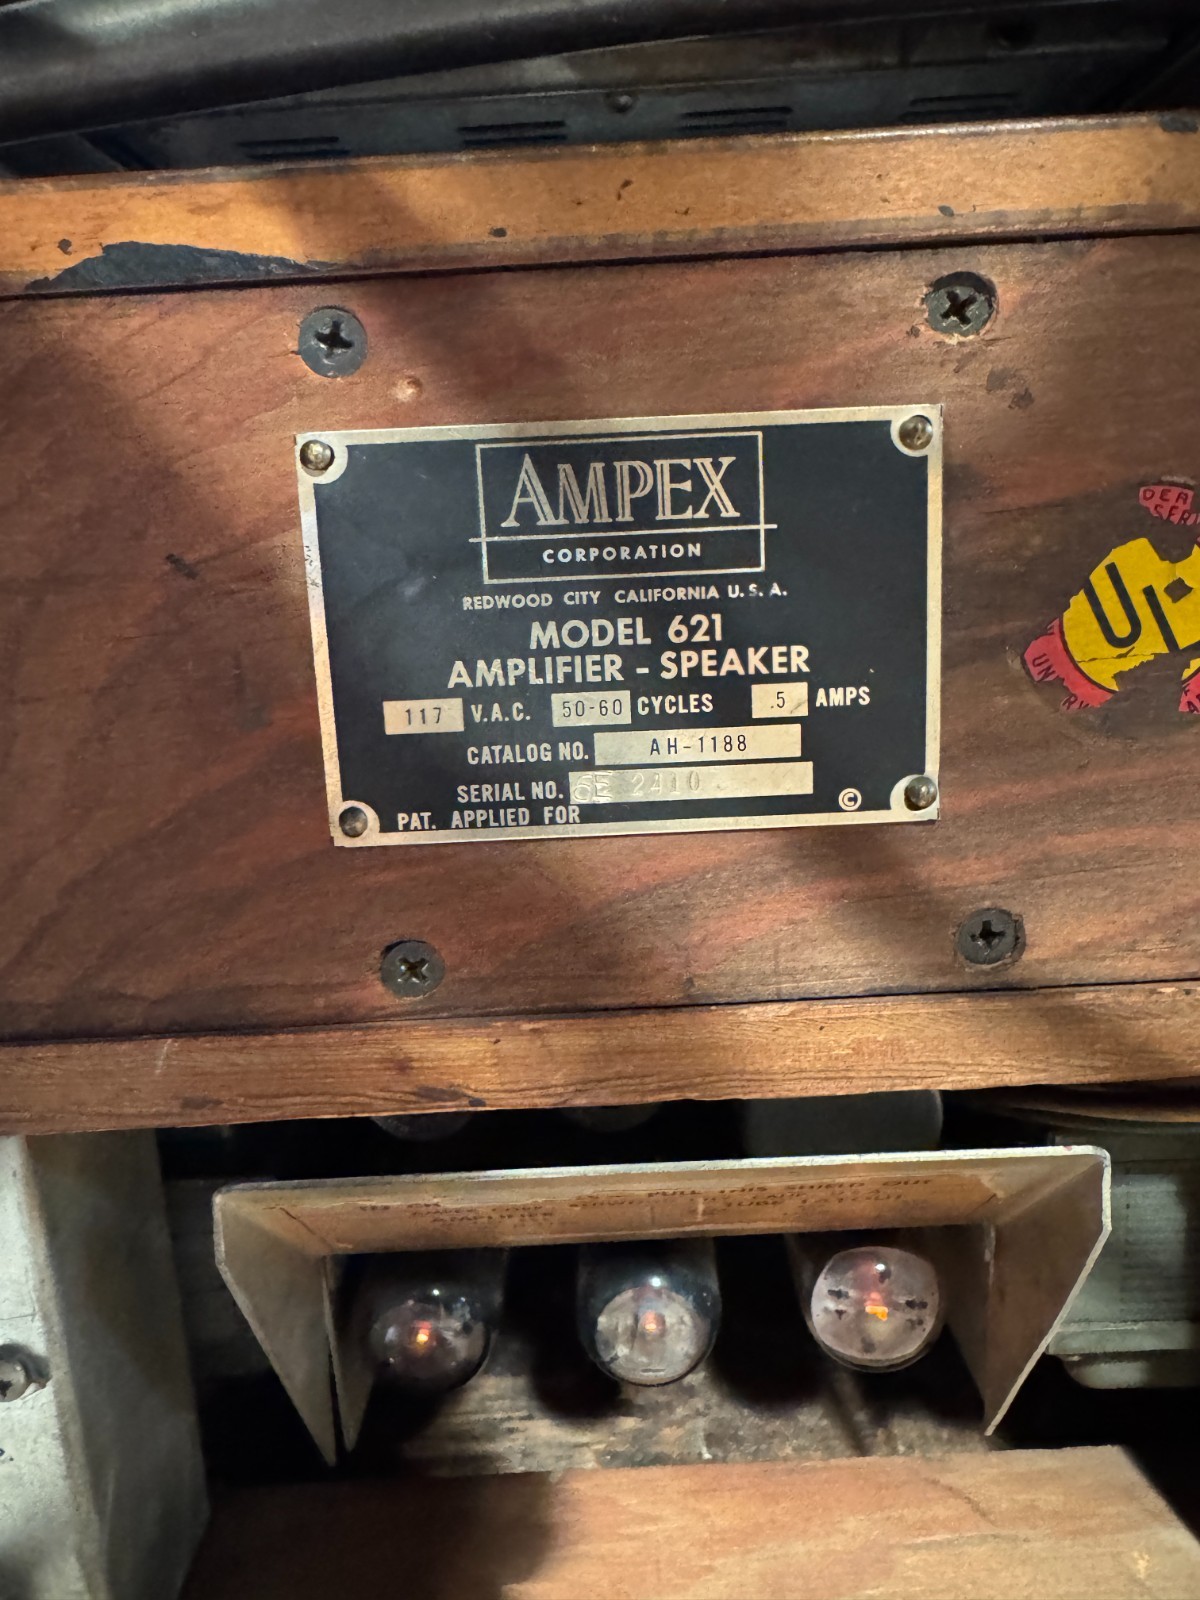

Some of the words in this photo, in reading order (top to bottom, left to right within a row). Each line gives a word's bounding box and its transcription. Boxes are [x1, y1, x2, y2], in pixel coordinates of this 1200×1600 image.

[500, 453, 741, 527] AMPEX
[542, 542, 702, 564] CORPORATION
[462, 592, 553, 611] REDWOOD
[563, 590, 602, 605] CITY
[614, 585, 720, 604] CALIFORNIA
[530, 617, 652, 650] MODEL
[667, 613, 723, 643] 621
[447, 653, 624, 689] AMPLIFIER
[660, 645, 811, 680] SPEAKER
[404, 707, 442, 726] 117
[470, 702, 531, 723] V.A.C.
[562, 698, 623, 718] 50-60
[637, 693, 714, 716] CYCLES
[770, 691, 786, 709] .5
[815, 686, 871, 708] AMPS
[467, 745, 552, 765] CATALOG
[558, 741, 589, 760] NO.
[649, 734, 748, 756] AH-1188
[457, 782, 526, 804] SERIAL
[531, 780, 564, 800] NO.
[397, 812, 437, 831] PAT.
[451, 807, 530, 829] APPLIED
[543, 805, 581, 824] FOR
